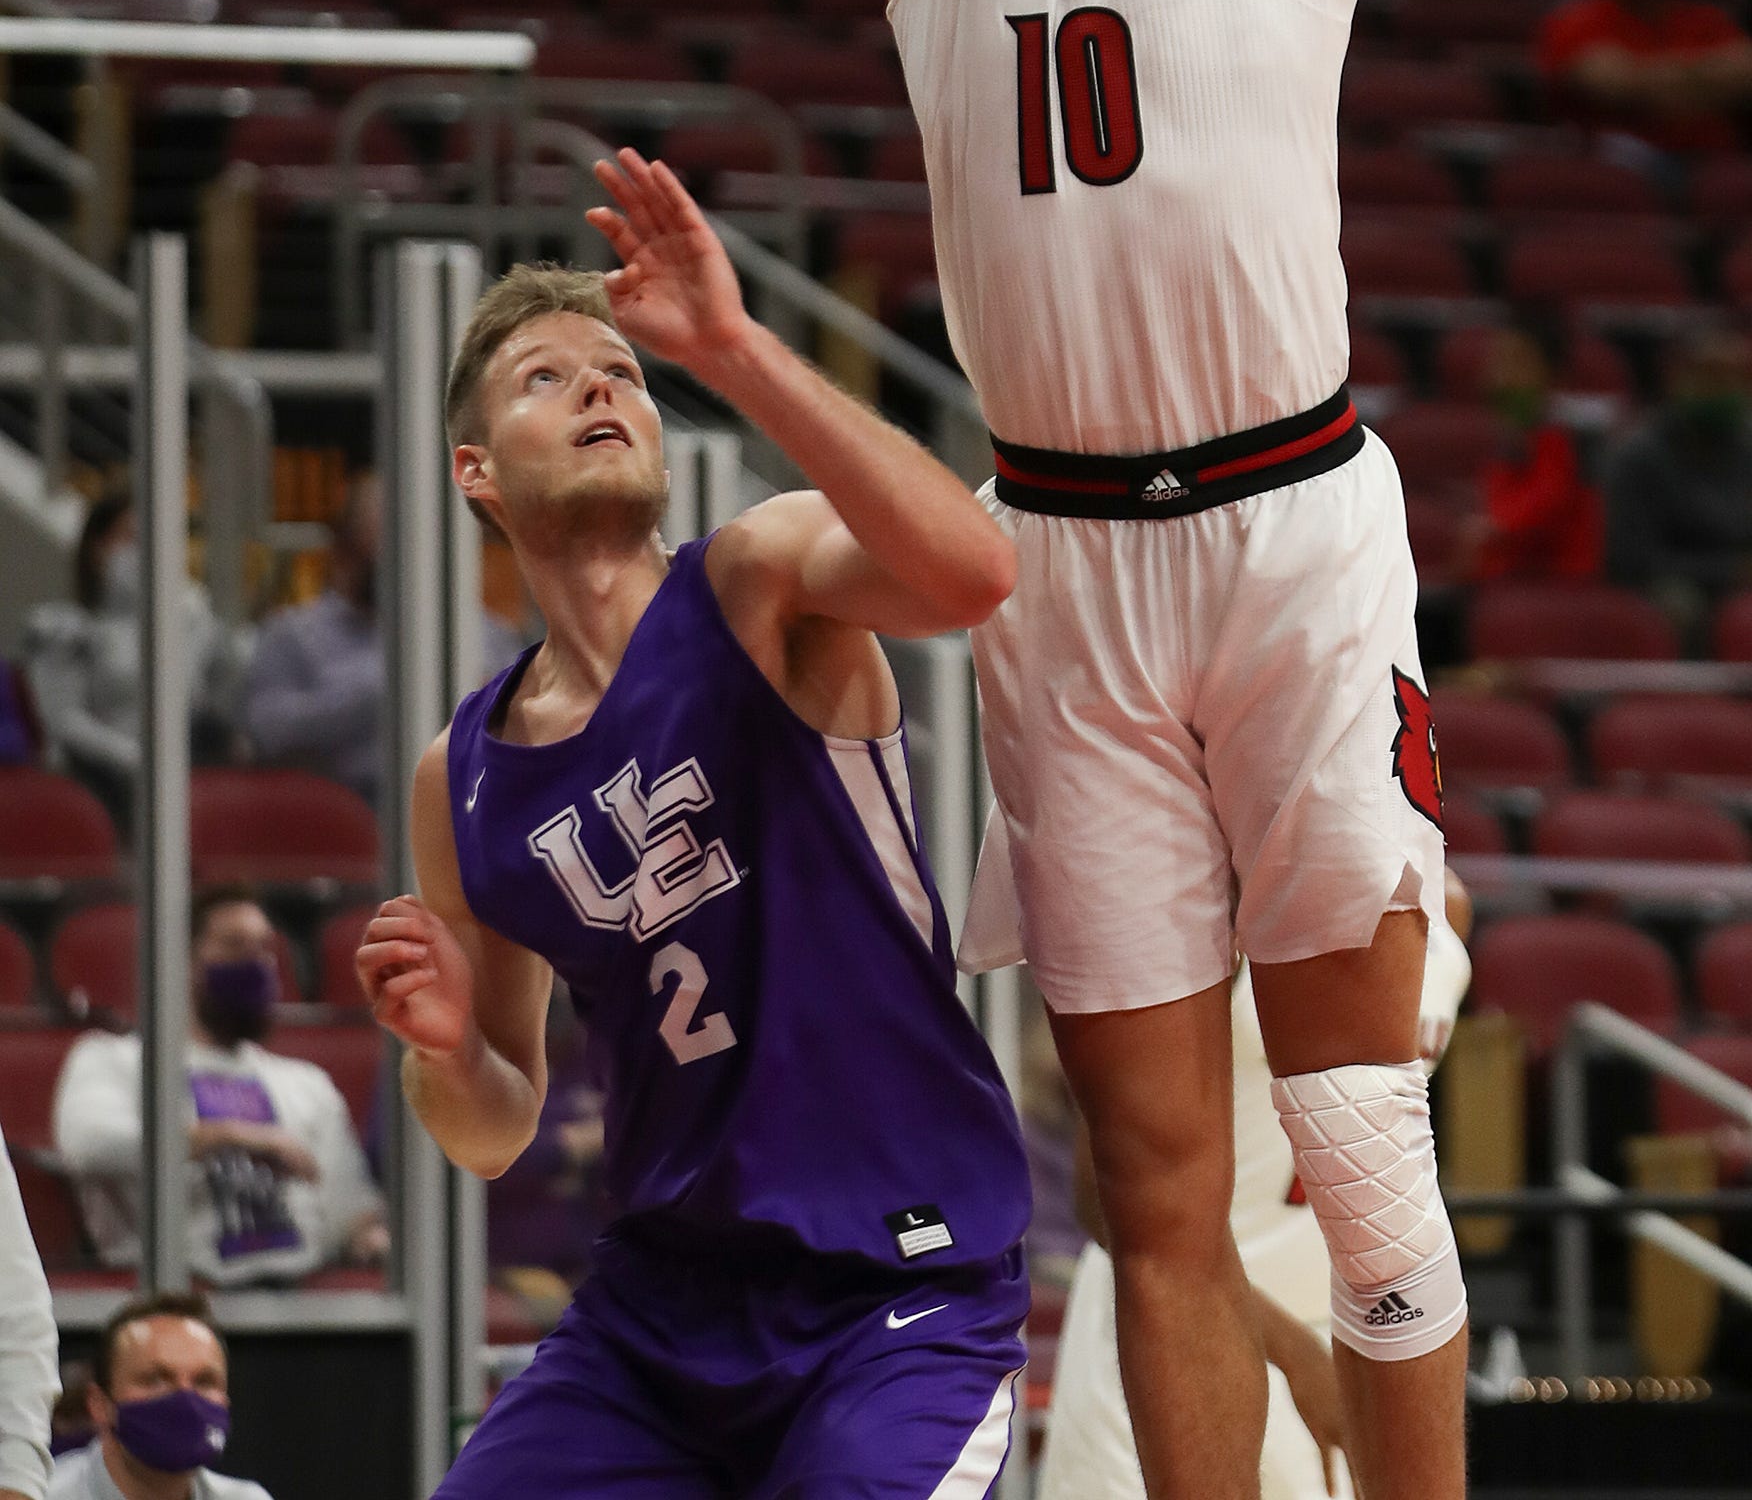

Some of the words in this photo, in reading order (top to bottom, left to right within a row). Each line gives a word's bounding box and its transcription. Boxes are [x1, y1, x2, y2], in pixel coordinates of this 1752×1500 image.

[1005, 6, 1144, 195] 10
[1141, 487, 1190, 501] adidas
[527, 756, 741, 943] UE
[649, 941, 738, 1066] 2
[905, 1212, 925, 1226] L
[1364, 1307, 1424, 1325] adidas
